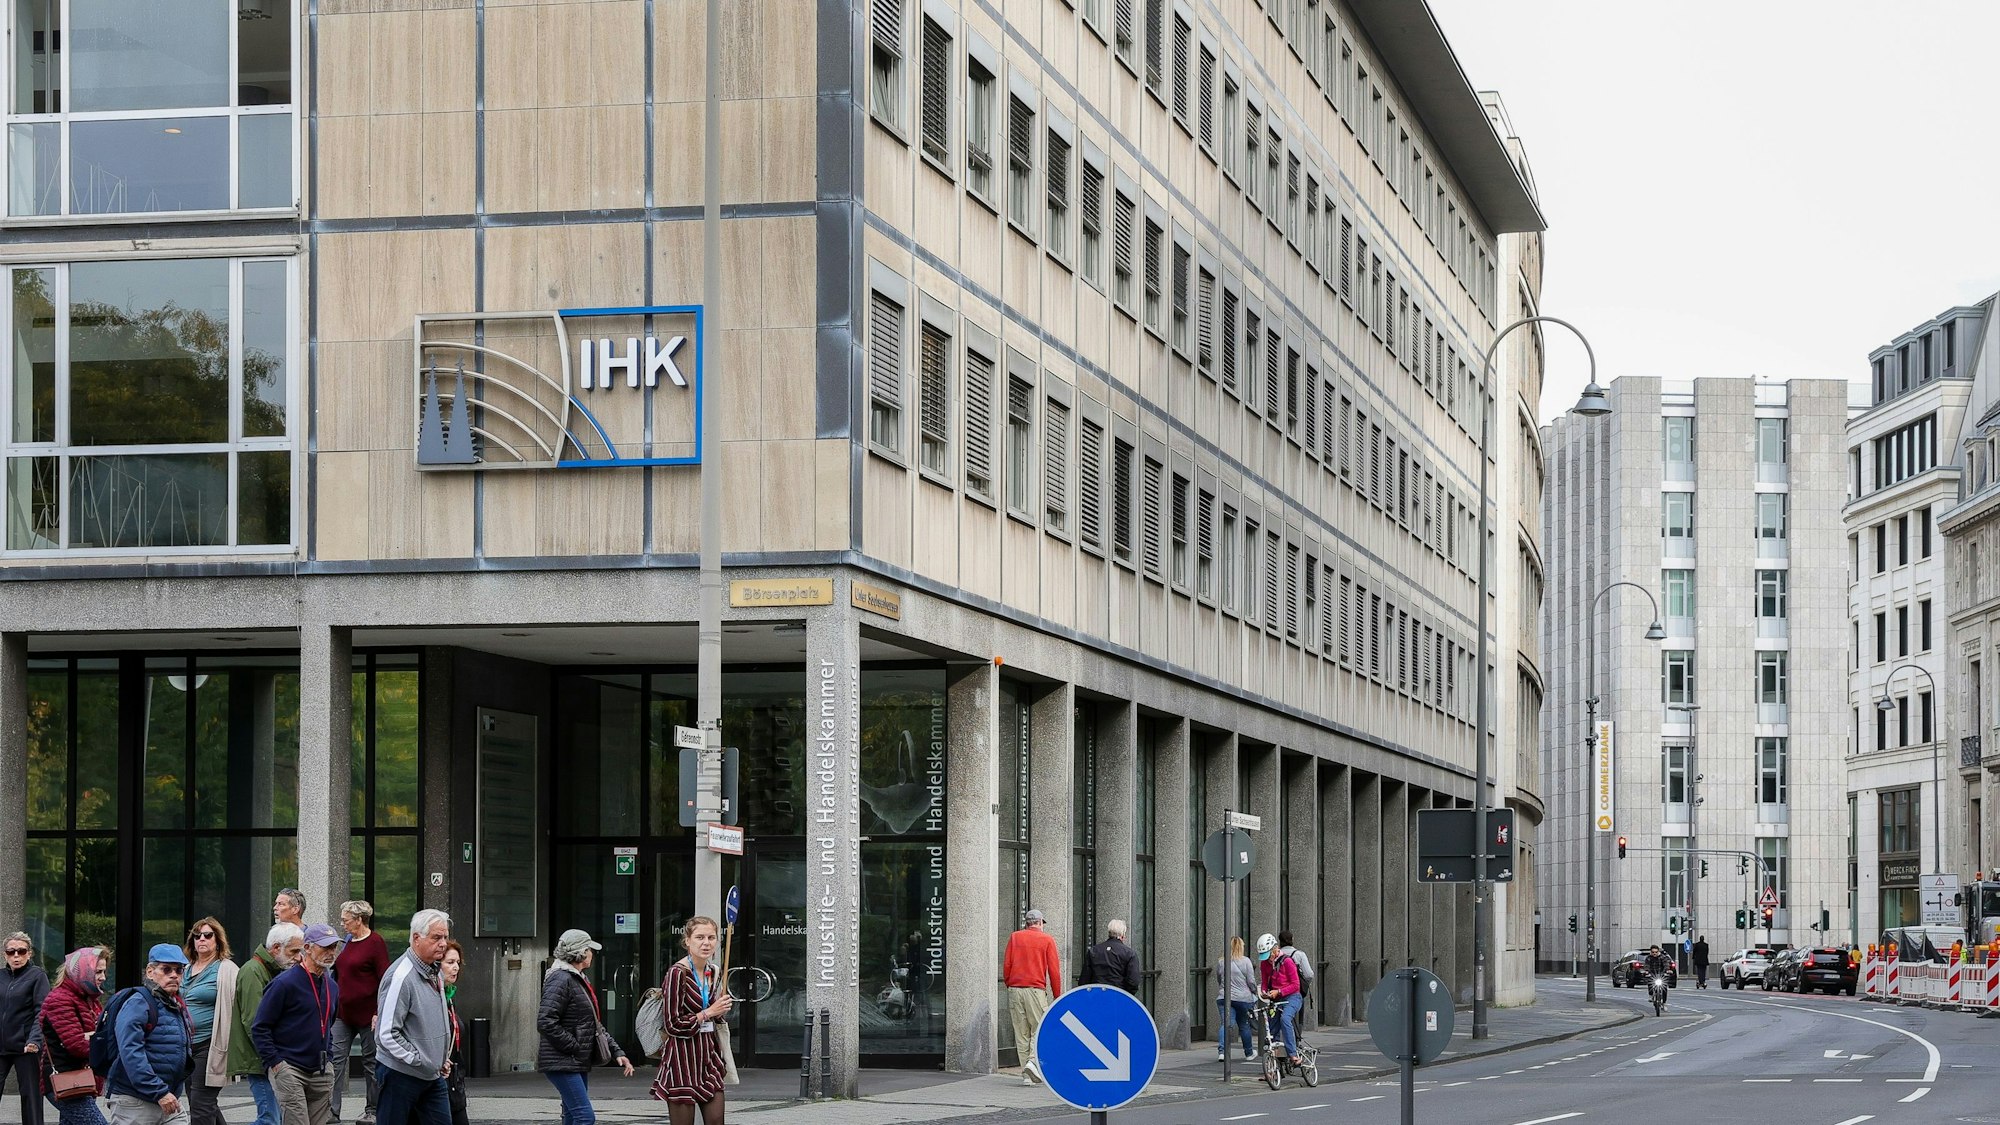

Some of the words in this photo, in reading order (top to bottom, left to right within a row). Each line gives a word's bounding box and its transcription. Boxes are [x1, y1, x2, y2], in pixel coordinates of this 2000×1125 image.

[581, 336, 688, 390] IHK
[742, 586, 819, 600] Börsenplatz
[816, 658, 835, 825] Handelskammer
[926, 690, 943, 832] Handelskammer
[1600, 724, 1609, 811] COMMERZBANK
[816, 836, 835, 877] und
[926, 846, 943, 879] und
[762, 924, 807, 935] Handelska
[816, 884, 835, 988] Industrie-
[926, 887, 943, 976] Industrie-
